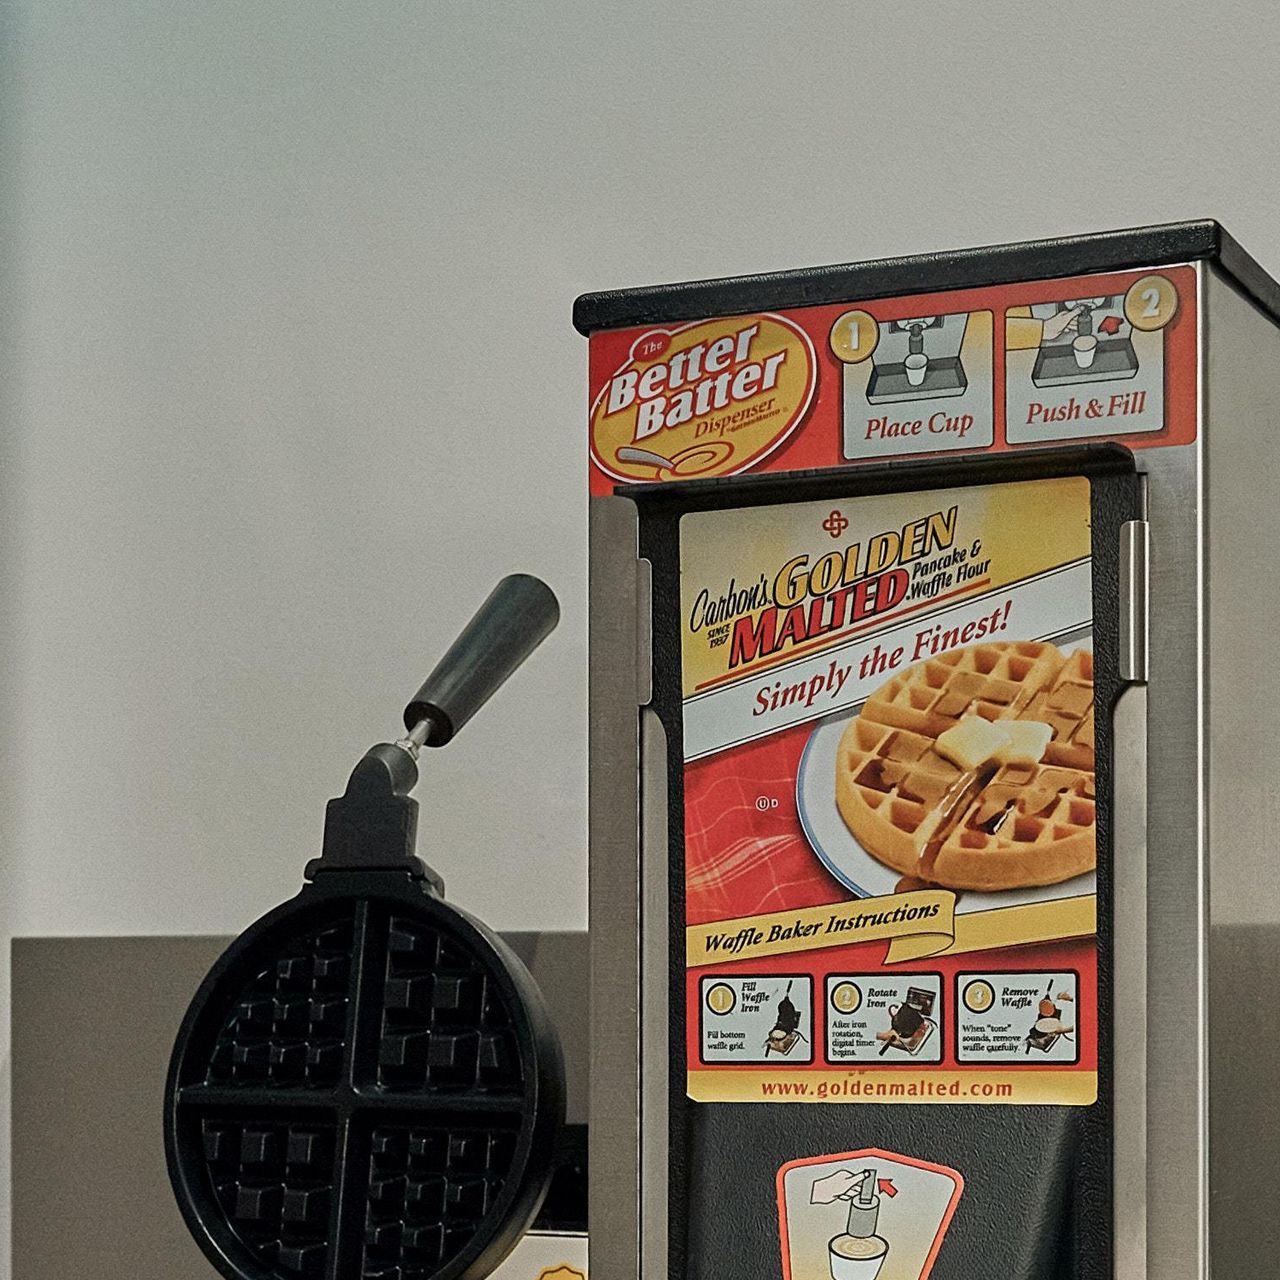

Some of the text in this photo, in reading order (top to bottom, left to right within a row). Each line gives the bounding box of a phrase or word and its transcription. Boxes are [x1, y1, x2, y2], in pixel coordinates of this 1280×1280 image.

[1141, 288, 1160, 318] 2
[849, 321, 859, 350] 1
[642, 341, 663, 356] The
[606, 324, 759, 415] Better
[635, 351, 786, 441] Batter
[1026, 391, 1147, 424] Push & Fill
[694, 398, 776, 438] Dispenser
[864, 412, 974, 440] Place Cup
[912, 539, 982, 580] Pancake &
[690, 505, 959, 633] Carbon's GOLDEN
[911, 559, 991, 600] Waffle Flour
[728, 569, 910, 669] MALTED
[706, 623, 731, 640] SINCE
[752, 600, 1013, 716] Simply the Finest!
[704, 901, 940, 953] Waffle Baker Instructions
[741, 982, 757, 992] Fill
[867, 988, 899, 998] Rotate
[1002, 987, 1039, 997] Remove
[741, 992, 771, 1004] Waffle
[866, 999, 887, 1009] Iron
[1001, 997, 1033, 1010] Waffle
[740, 1003, 761, 1013] Iron
[832, 1020, 868, 1029] After iron
[962, 1024, 985, 1033] When
[720, 1031, 746, 1040] bottom
[832, 1030, 864, 1040] rotation,
[962, 1034, 991, 1043] sounds,
[707, 1042, 729, 1050] waffle
[832, 1038, 875, 1048] digital timer
[962, 1043, 985, 1052] waffle
[761, 1079, 1013, 1099] www.goldenmalted.com
